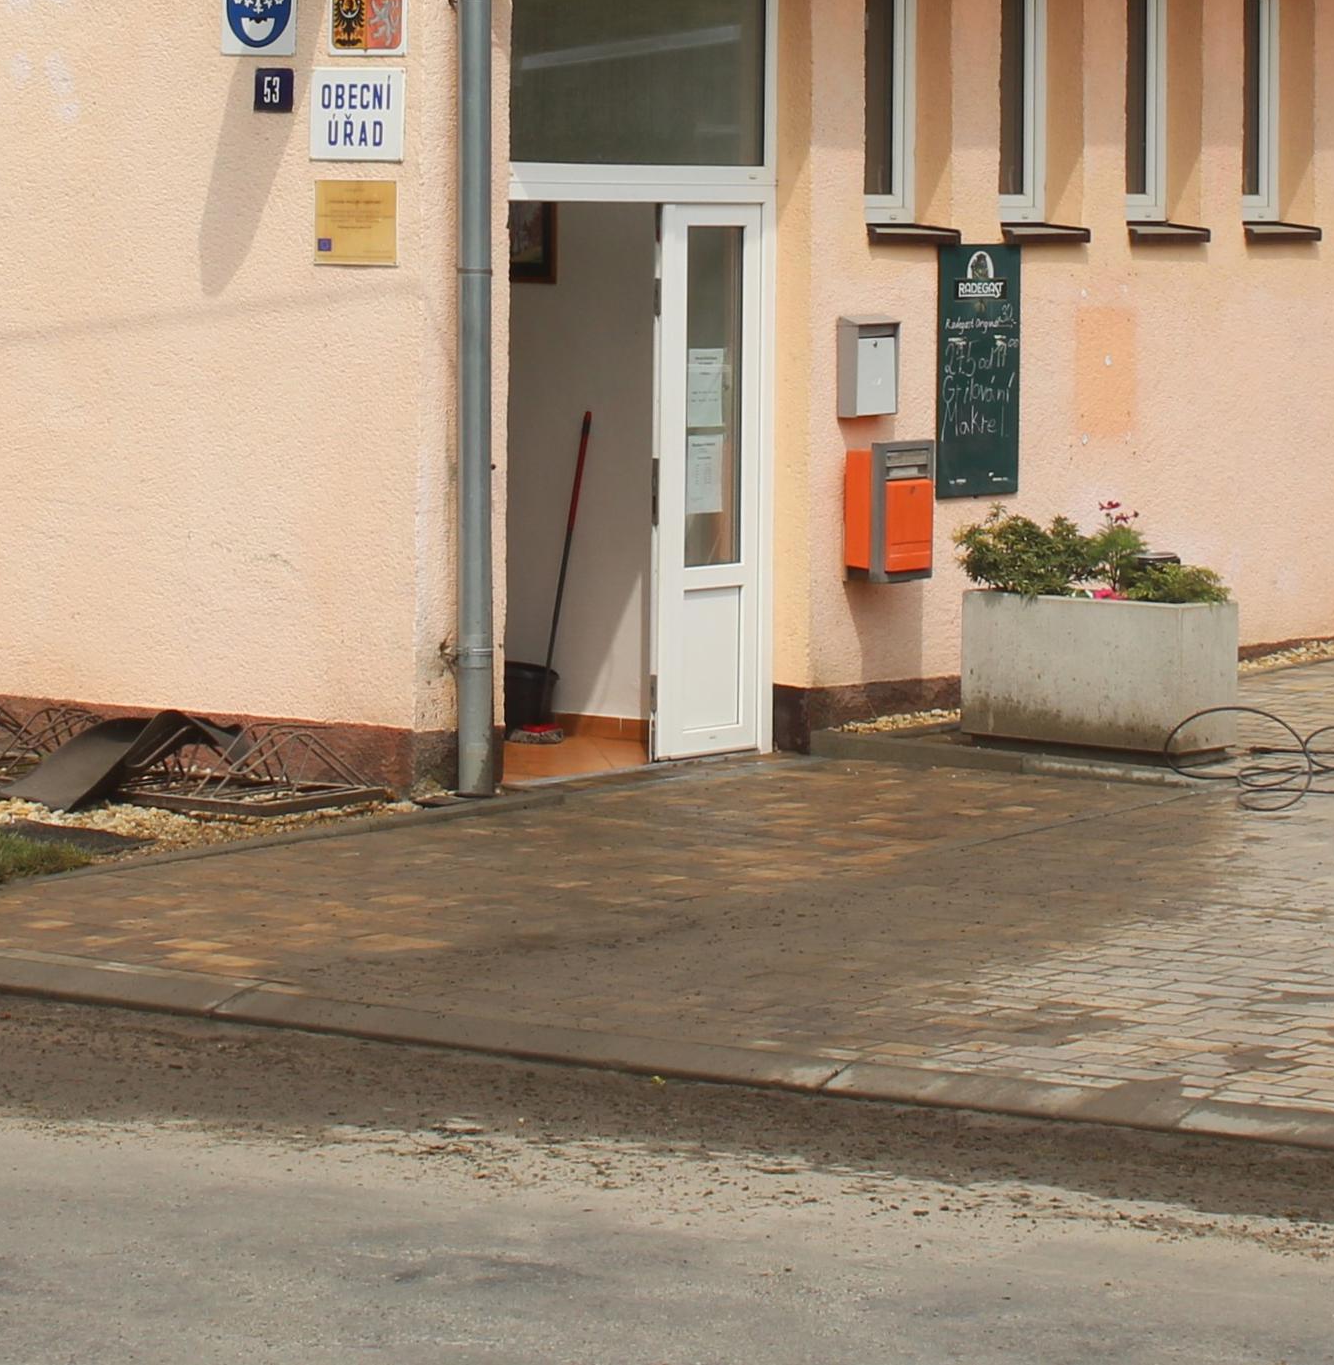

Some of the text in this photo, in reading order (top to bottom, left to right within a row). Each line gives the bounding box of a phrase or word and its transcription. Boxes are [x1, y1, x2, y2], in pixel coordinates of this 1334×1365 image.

[263, 75, 281, 104] 53
[321, 74, 391, 110] OBECNÍ
[328, 113, 384, 147] ÚŘAD
[958, 282, 1004, 298] RADEGAST
